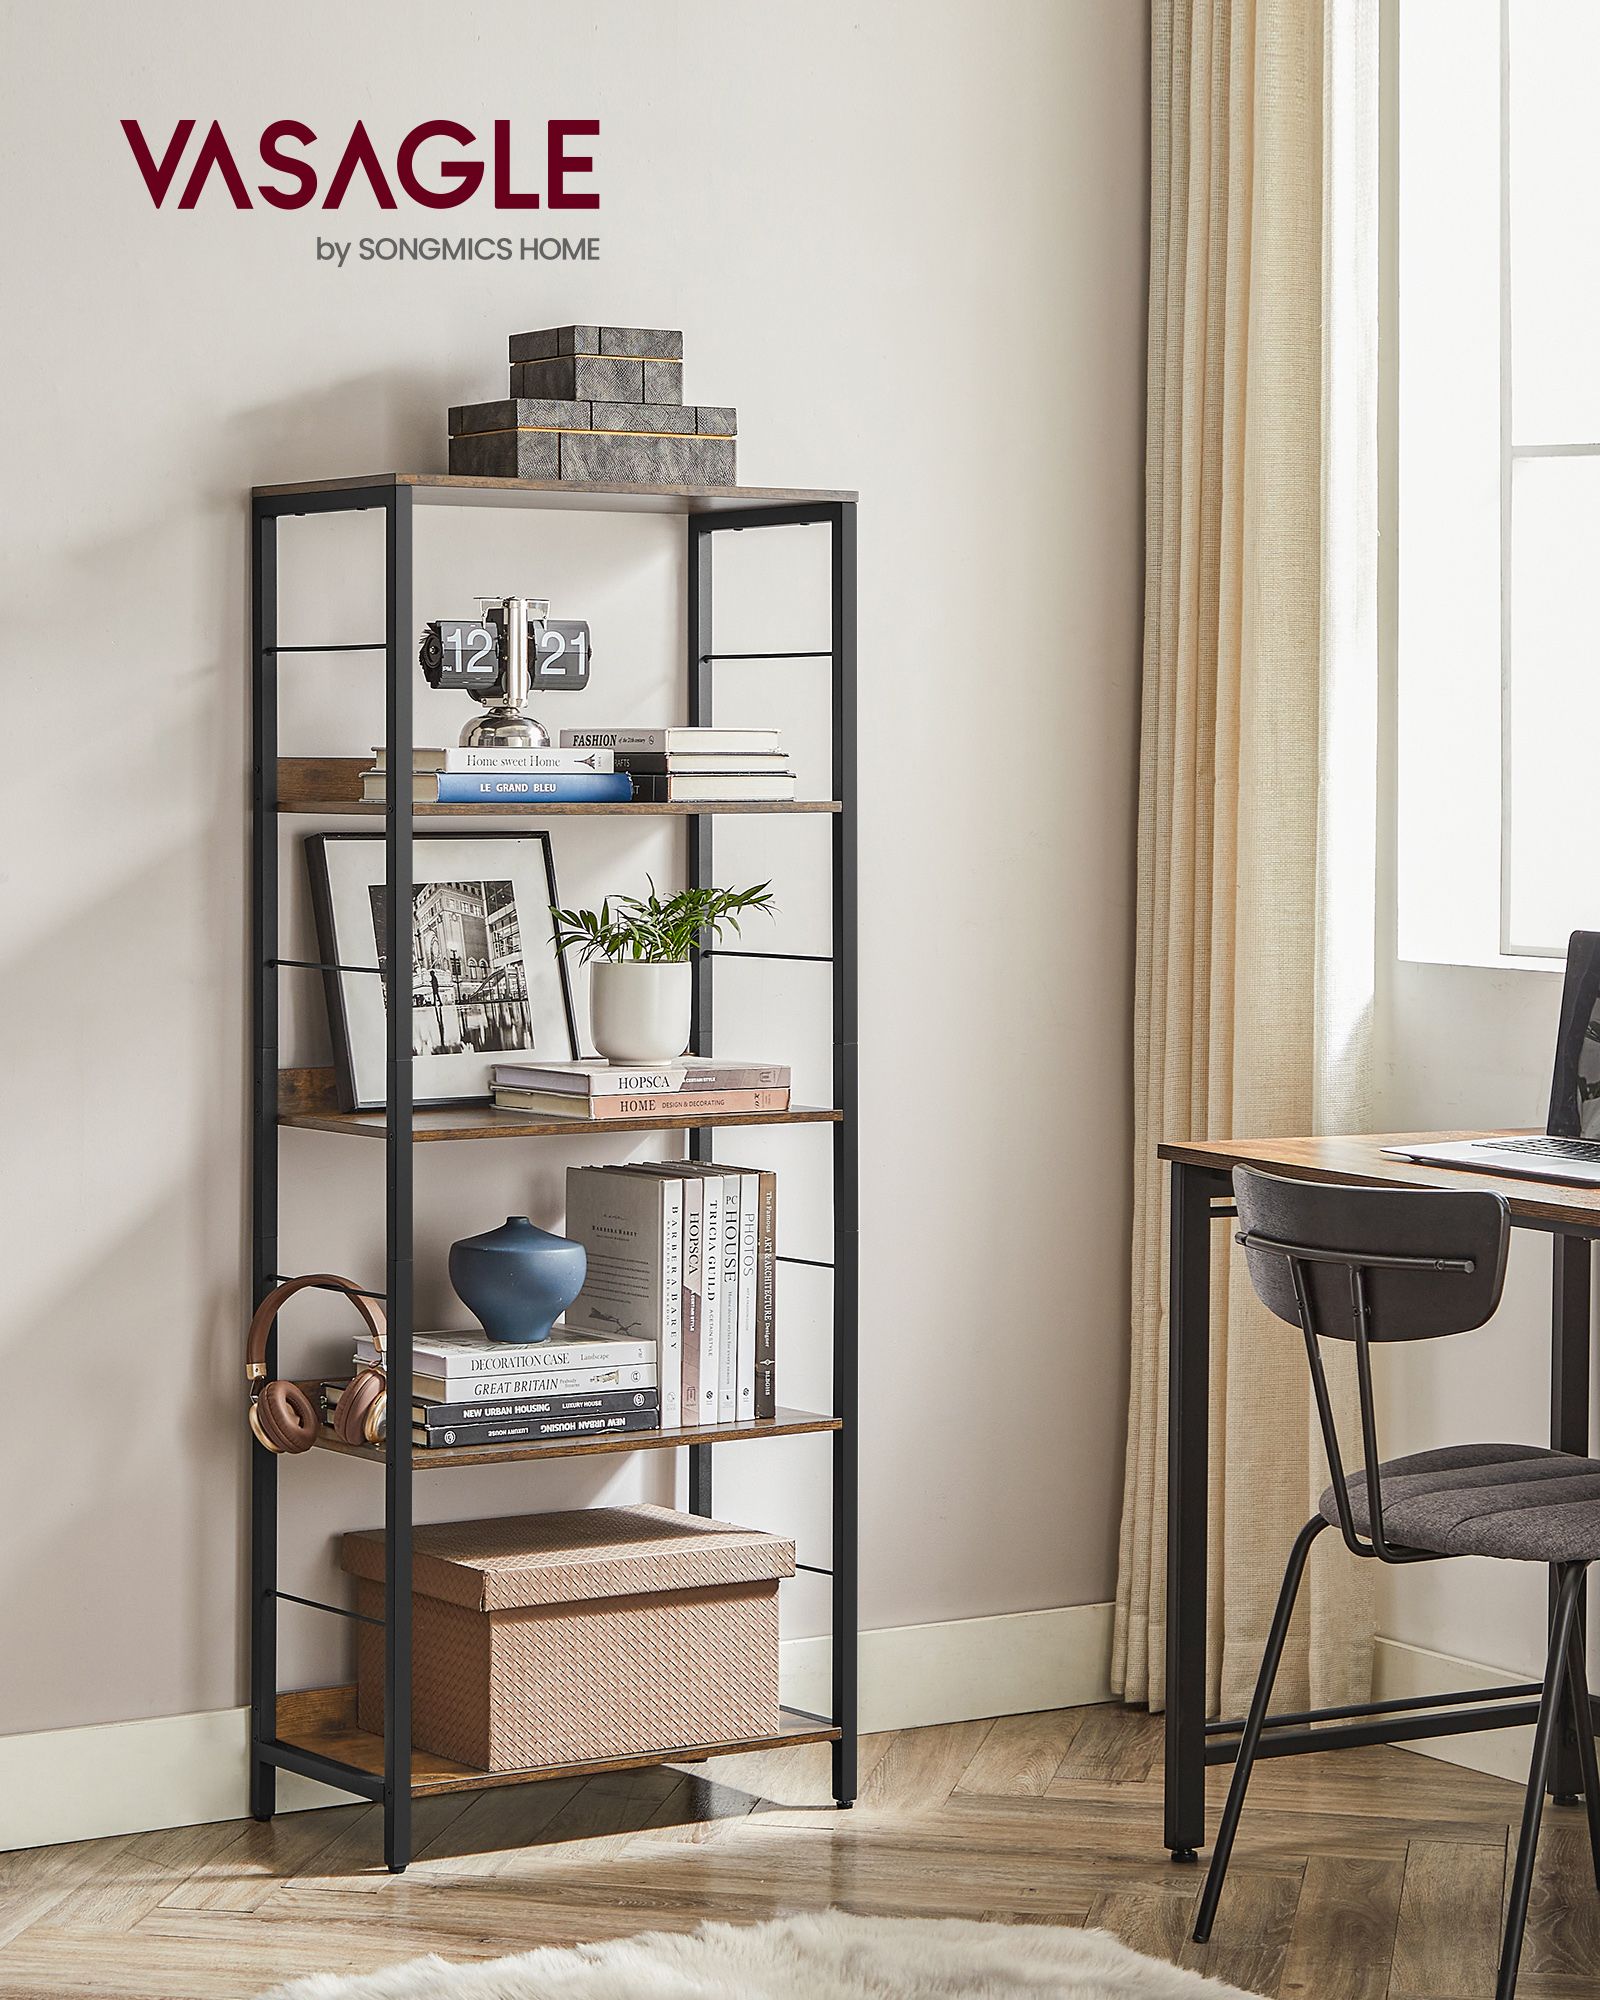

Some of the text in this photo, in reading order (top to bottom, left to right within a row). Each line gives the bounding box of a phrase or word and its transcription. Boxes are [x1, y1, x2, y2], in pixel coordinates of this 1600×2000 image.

[447, 629, 493, 672] 12
[540, 632, 585, 675] 21
[572, 734, 618, 747] FASHION
[467, 755, 561, 767] Home sweet Home
[614, 758, 631, 768] RAFTS
[480, 783, 557, 792] LE GRAND BLEU
[618, 1076, 671, 1090] HOPSCA
[620, 1099, 656, 1112] HOME
[662, 1101, 683, 1109] DESIGN
[689, 1099, 725, 1108] DECORATING
[725, 1195, 738, 1205] PC
[708, 1200, 718, 1251] TRICIA
[688, 1212, 700, 1275] HOPSCA
[724, 1210, 737, 1283] HOUSE
[743, 1213, 755, 1277] PHOTOS
[764, 1236, 772, 1253] ART
[707, 1256, 716, 1301] GUILD
[764, 1260, 772, 1321] ARCHITECTURE
[670, 1293, 678, 1350] BAREY
[471, 1354, 542, 1371] DECORATION
[544, 1353, 570, 1366] CASE
[474, 1381, 512, 1396] GREAT
[513, 1378, 559, 1393] BRITAIN
[463, 1408, 482, 1419] NEW
[485, 1406, 512, 1417] URBAN
[515, 1403, 551, 1414] HOUSING
[584, 1400, 603, 1408] HOUSE
[488, 1417, 626, 1437] NEW URBAN HOUSING LUXURY HOUSE
